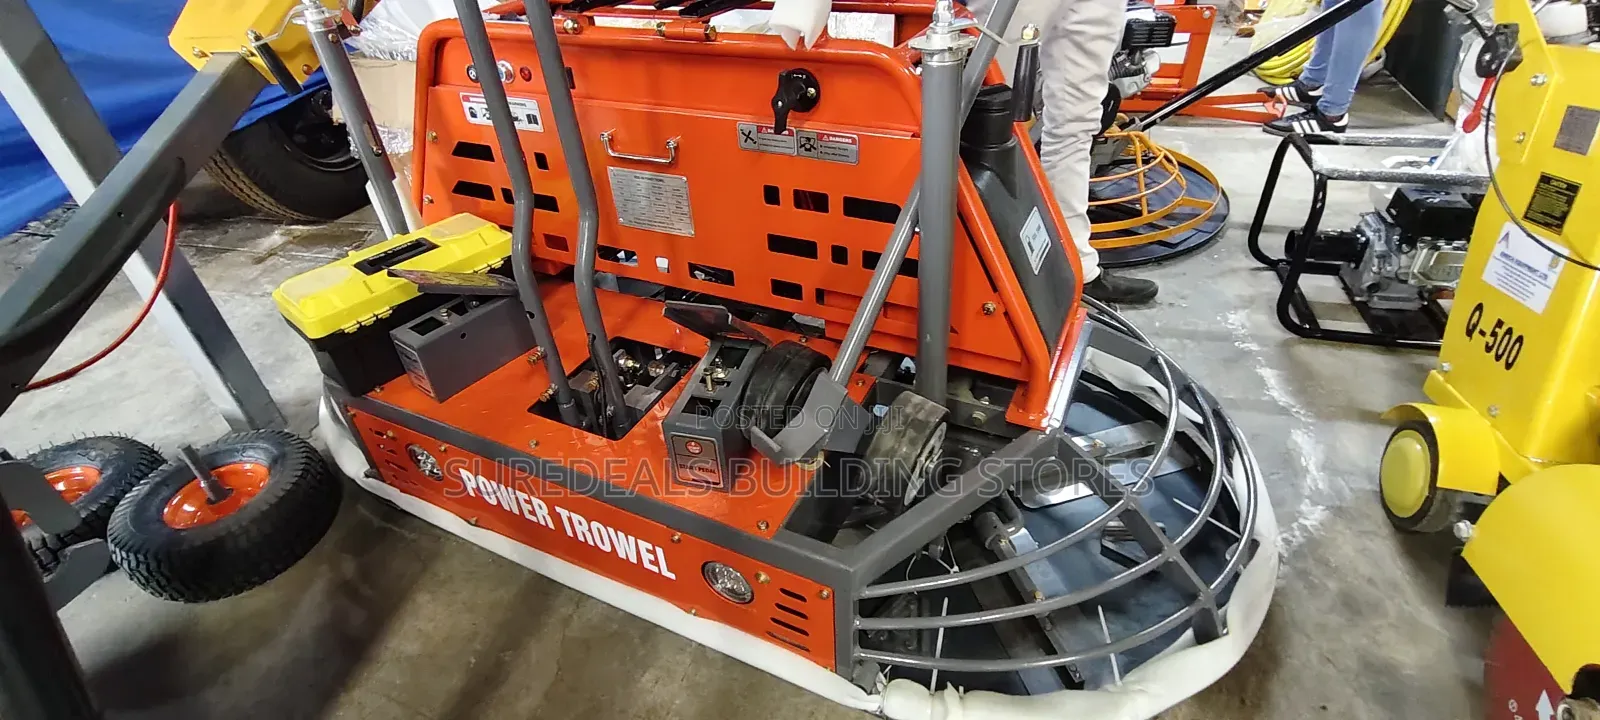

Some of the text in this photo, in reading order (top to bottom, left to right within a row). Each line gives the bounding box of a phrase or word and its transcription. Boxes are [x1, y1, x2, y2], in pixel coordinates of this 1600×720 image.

[1465, 302, 1524, 371] Q-500
[697, 466, 717, 475] PEDAL
[458, 467, 677, 580] POWER TROWEL
